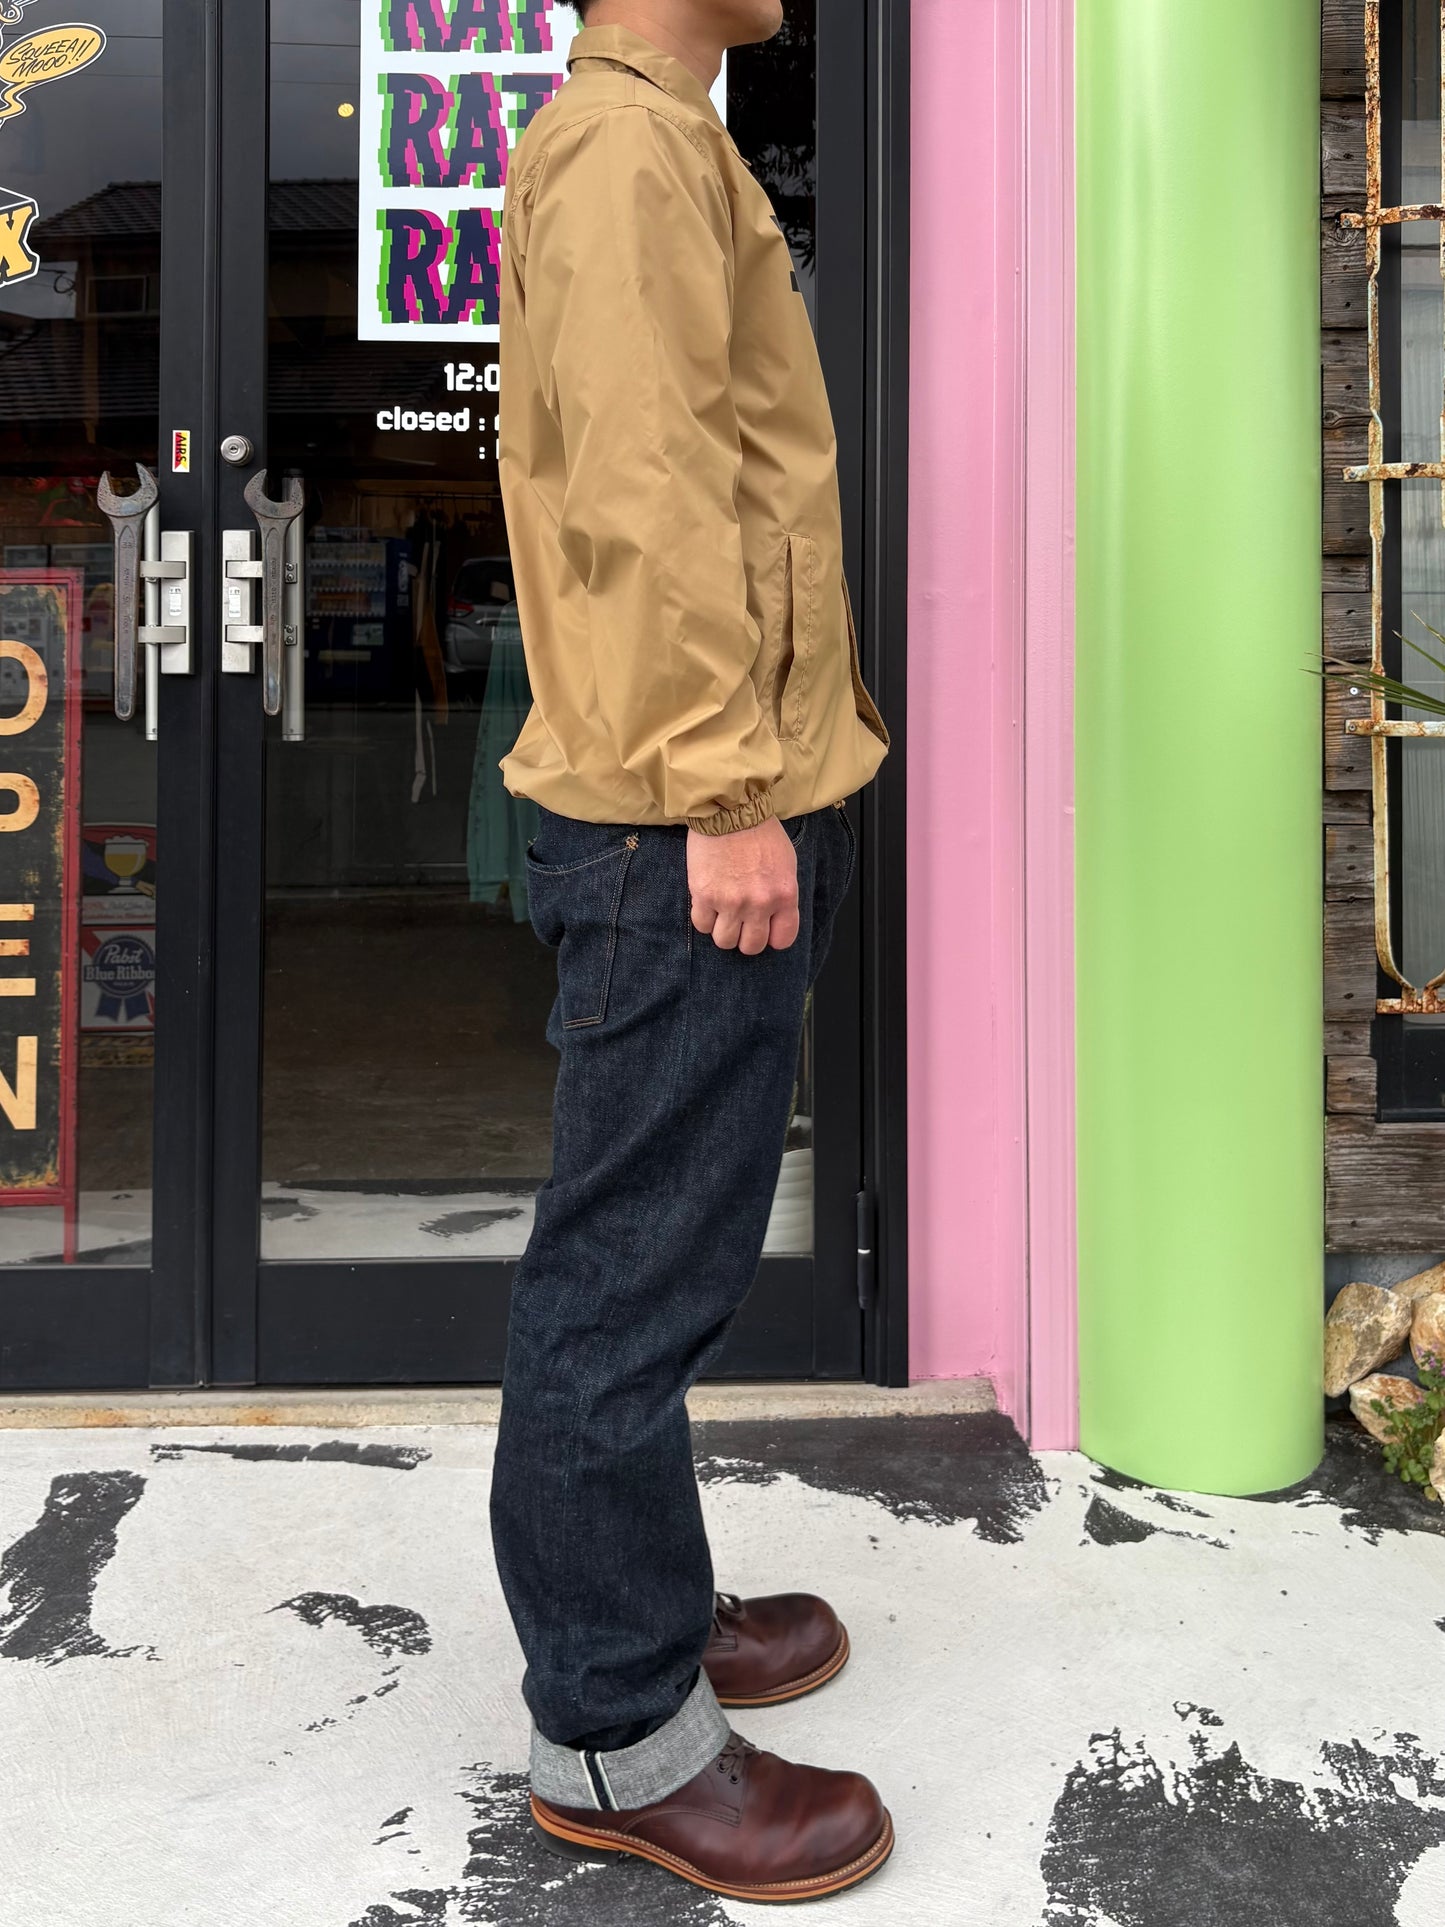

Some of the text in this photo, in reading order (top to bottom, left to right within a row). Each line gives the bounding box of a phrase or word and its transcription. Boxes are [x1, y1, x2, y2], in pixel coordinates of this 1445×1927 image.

[6, 37, 96, 65] SQUEEA!!
[12, 54, 68, 78] MOOO
[377, 72, 564, 189] RAT
[376, 208, 501, 325] RA
[376, 405, 470, 432] closed
[175, 432, 187, 463] AIRS
[103, 944, 144, 964] Pabst
[85, 965, 156, 980] Blue Ribbo
